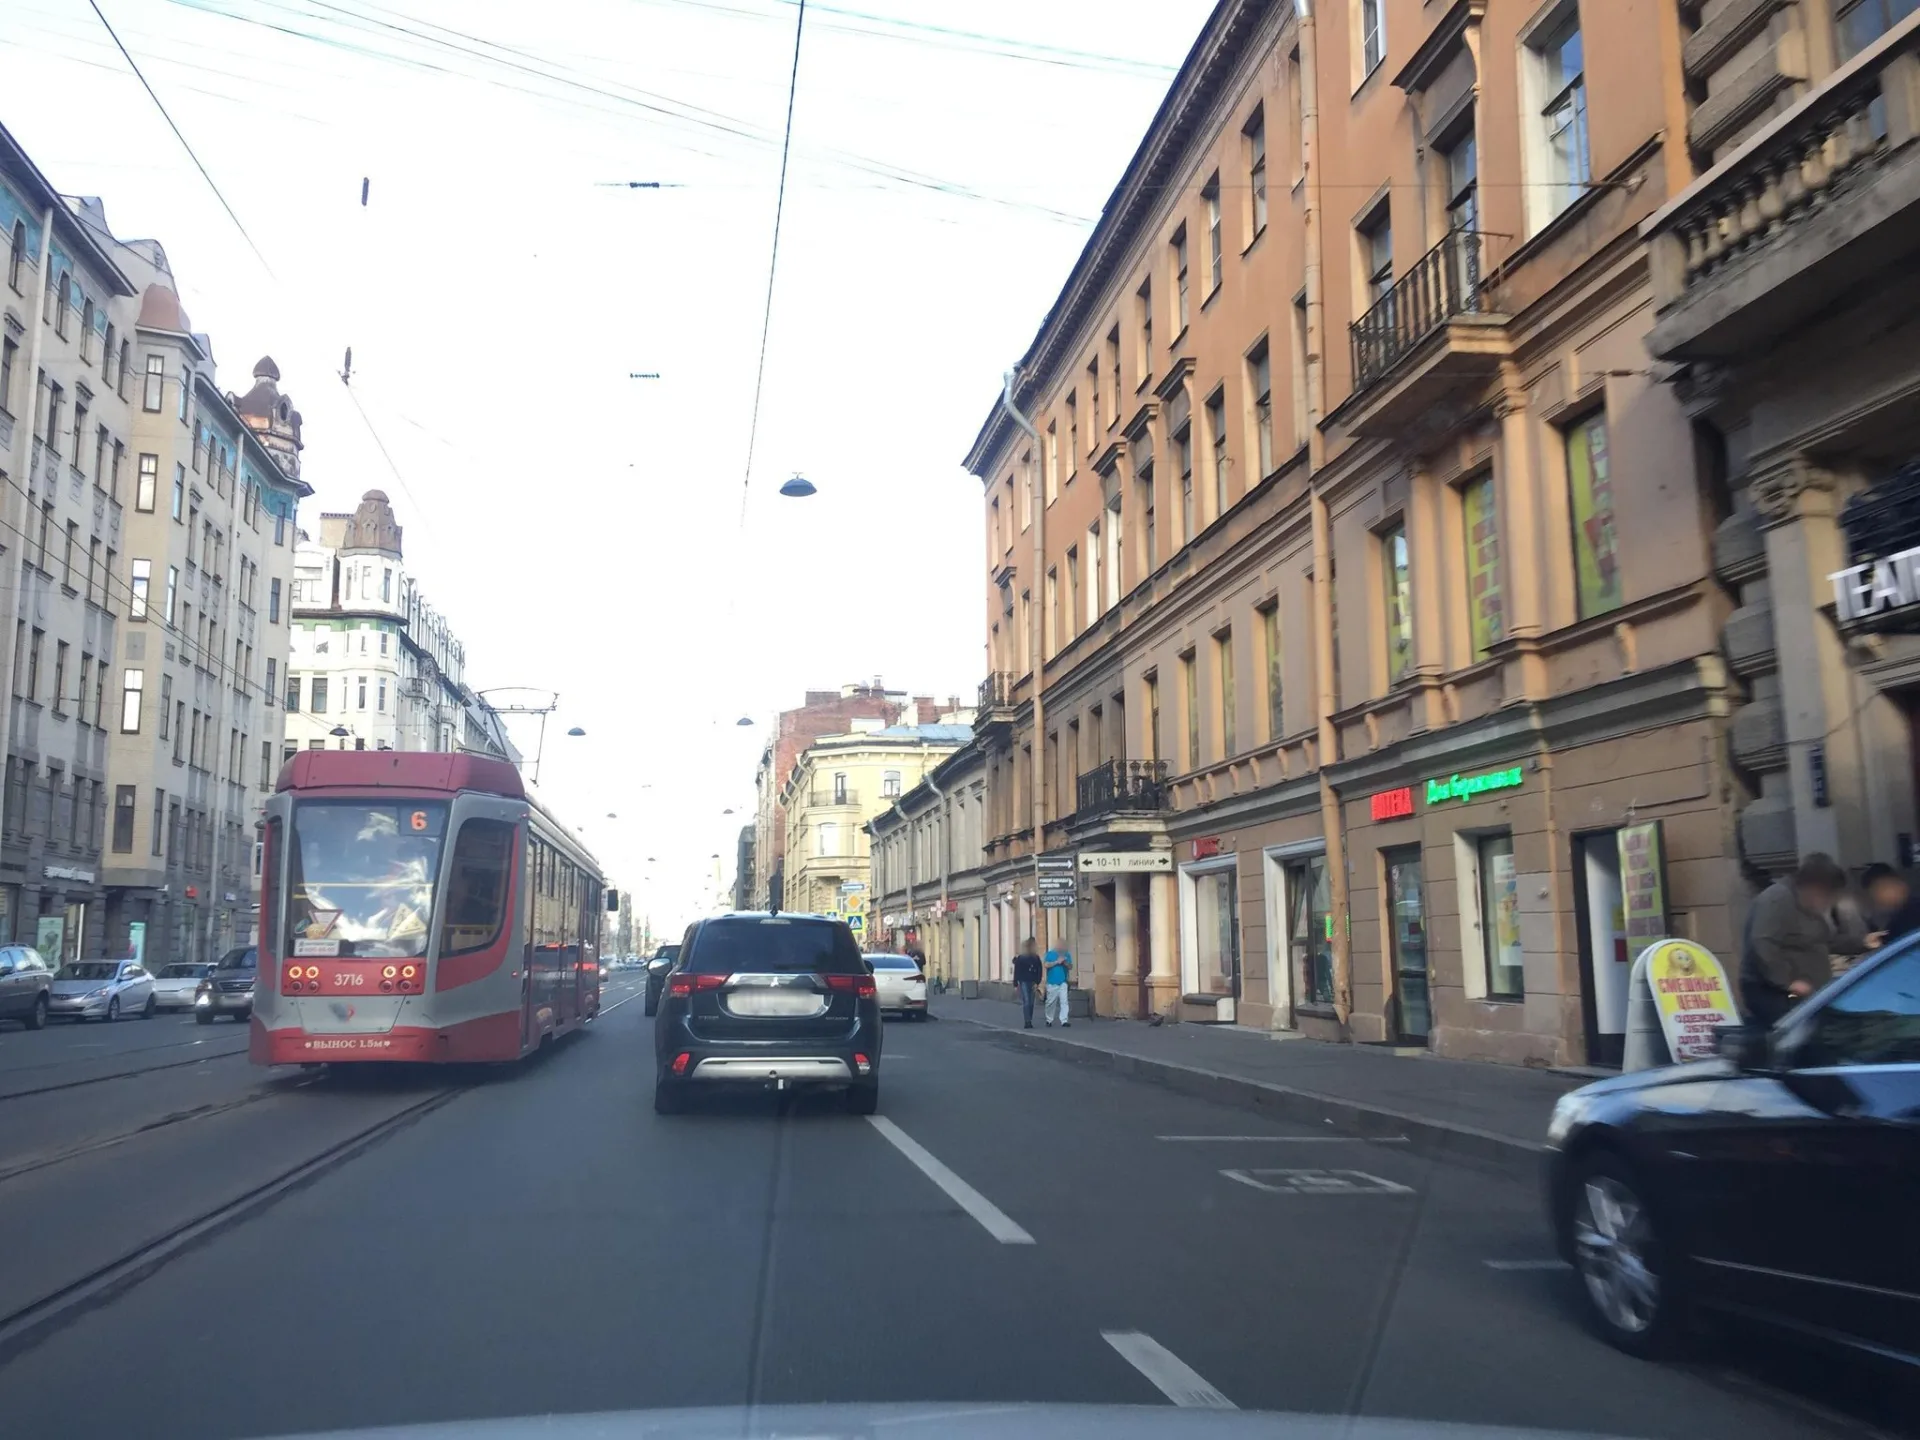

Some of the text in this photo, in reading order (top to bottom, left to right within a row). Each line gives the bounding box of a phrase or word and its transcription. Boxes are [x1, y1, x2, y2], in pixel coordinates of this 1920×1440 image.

[411, 811, 427, 831] 6
[1097, 857, 1120, 867] 10-11
[334, 974, 364, 986] 3716
[1658, 976, 1723, 993] СМЕШНЫЕ
[1676, 993, 1712, 1011] ЦЕНЫ
[1674, 1013, 1725, 1024] ОДЕЖДА
[312, 1040, 356, 1049] ВЫНОС
